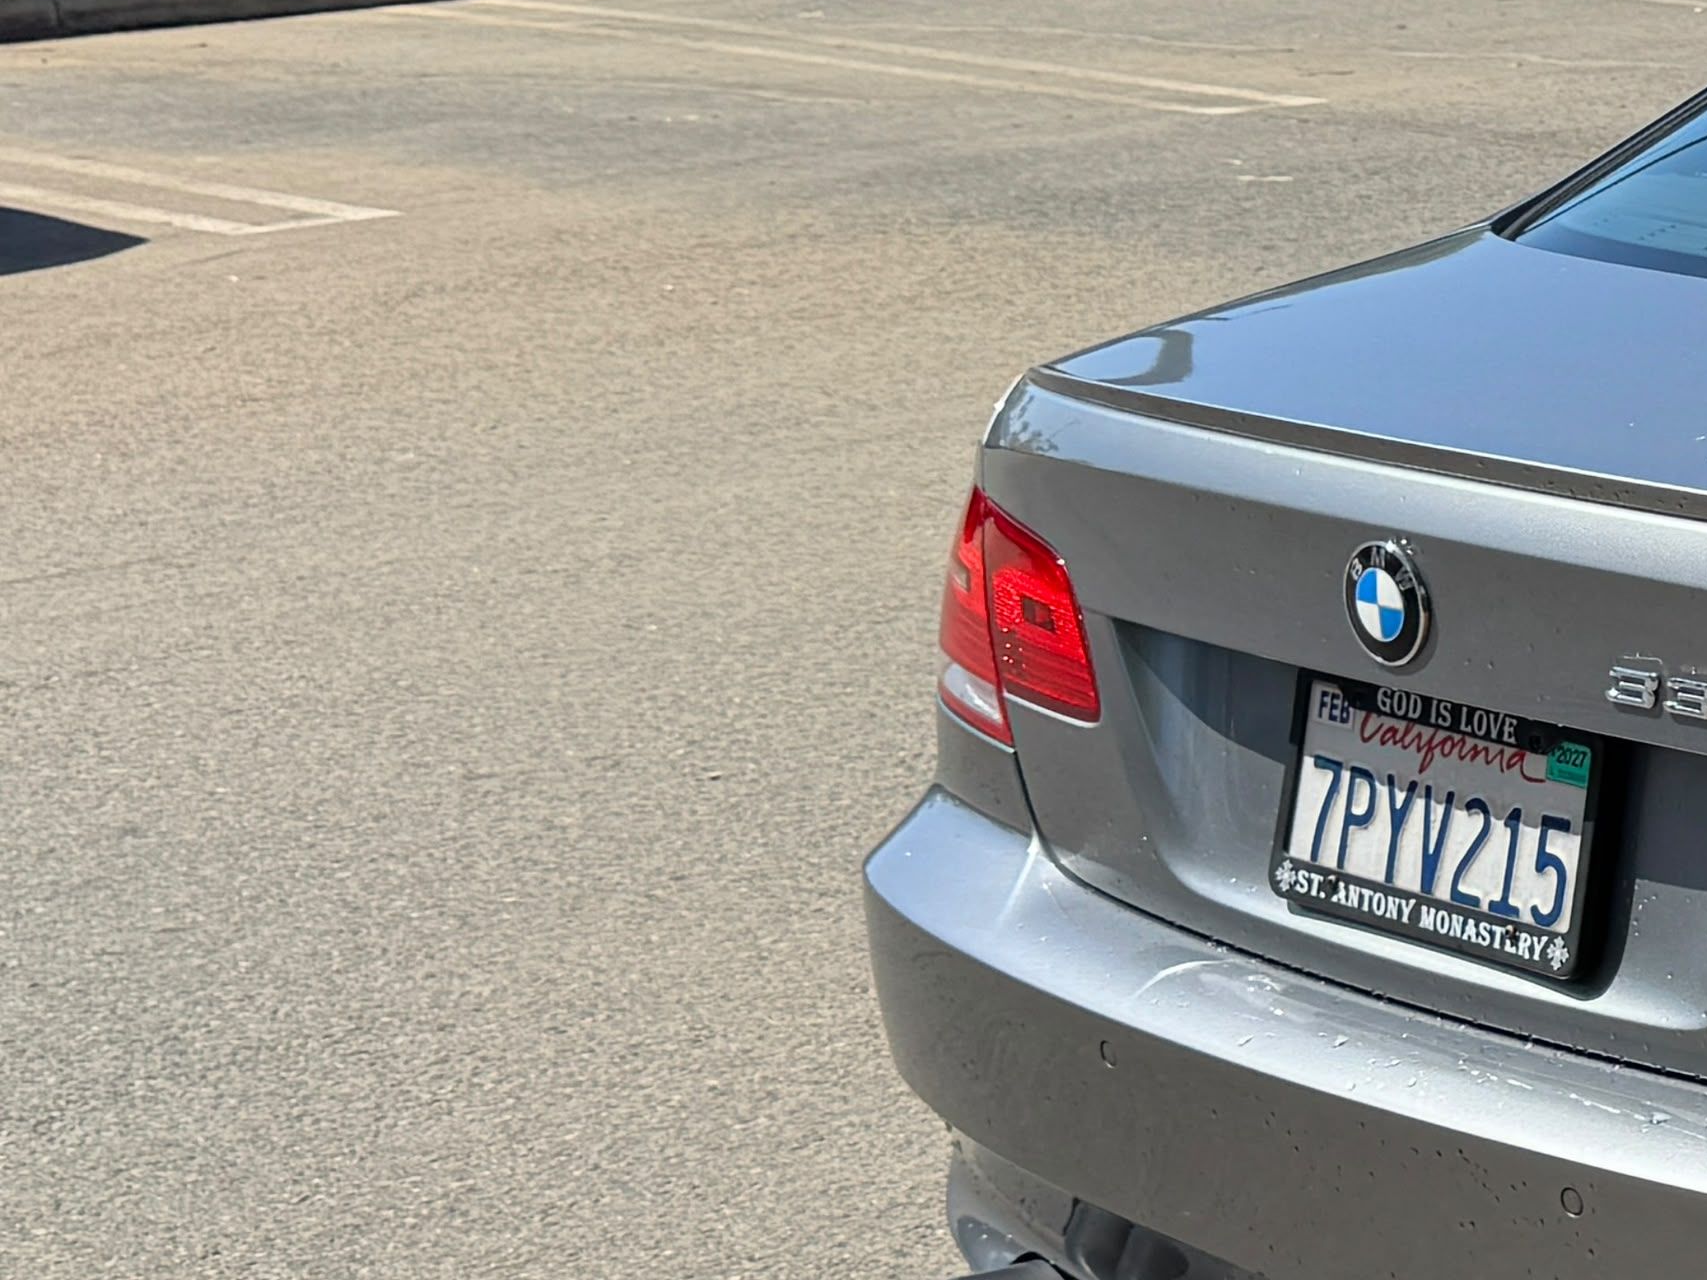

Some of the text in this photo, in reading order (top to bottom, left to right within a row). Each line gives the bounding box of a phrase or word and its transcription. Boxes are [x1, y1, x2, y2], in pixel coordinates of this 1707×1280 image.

[1350, 545, 1415, 591] BMW
[1318, 690, 1350, 724] FEB
[1376, 686, 1519, 744] GOD IS LOVE
[1359, 710, 1546, 783] California
[1556, 745, 1588, 769] 2027
[1309, 753, 1572, 928] 7PYV215
[1294, 869, 1326, 899] ST.
[1330, 880, 1417, 926] ANTONY
